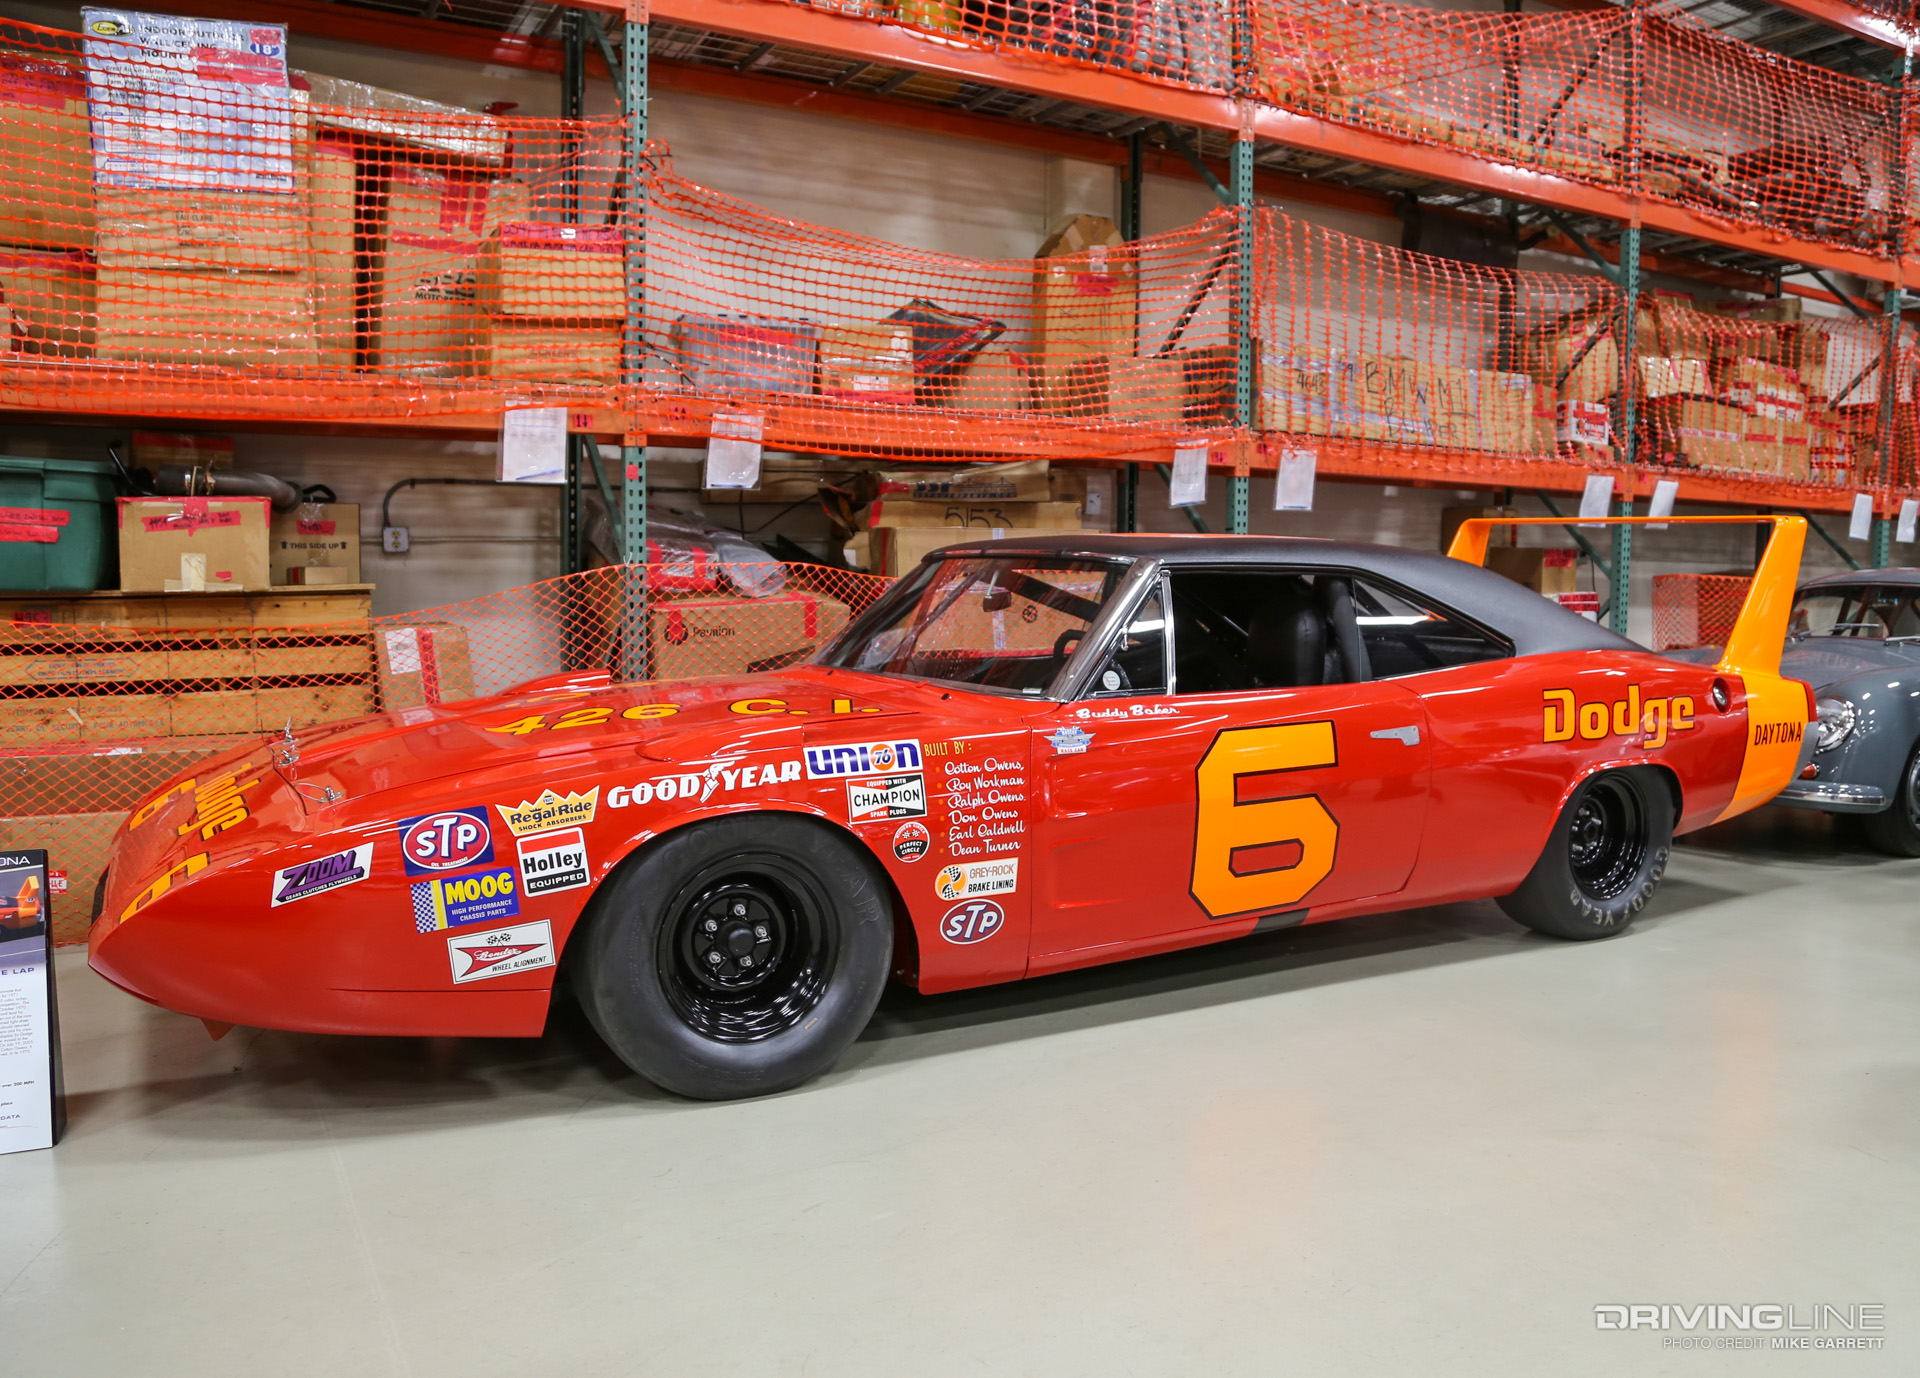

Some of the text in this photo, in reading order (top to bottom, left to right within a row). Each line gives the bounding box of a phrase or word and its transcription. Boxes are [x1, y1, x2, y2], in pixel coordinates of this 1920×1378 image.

[290, 542, 307, 550] THIS
[309, 542, 327, 550] SIDE
[485, 702, 682, 736] 426
[1076, 708, 1129, 719] Buddy
[1542, 683, 1695, 751] Dodge
[1754, 722, 1802, 746] DAYTONA
[924, 742, 949, 756] BUILT
[945, 761, 981, 775] Cotton
[607, 760, 802, 808] GOODYEAR
[866, 779, 892, 788] EQUIPPED
[946, 774, 1025, 792] Roy Workman
[854, 789, 920, 807] CHAMPION
[948, 792, 986, 809] Ralph
[519, 814, 587, 832] SHOCK ABSORBERS
[870, 810, 887, 818] SPARK
[948, 806, 1018, 825] Don Owens
[1188, 719, 1341, 920] 6
[415, 816, 478, 858] STP
[949, 820, 1026, 841] Earl Caldwell
[899, 841, 923, 850] PERFECT
[901, 847, 920, 855] CIRCLE
[948, 839, 1021, 857] Dean Turner
[523, 851, 583, 875] Holley
[970, 863, 1014, 879] GREY-ROCK
[278, 850, 360, 899] ZOOM
[530, 872, 584, 890] EQUIPPED
[285, 874, 357, 900] GEARS CLUTCHES FLYWHEELS
[445, 872, 514, 905] MOOG
[968, 879, 1014, 893] BRAKE LINING
[452, 899, 513, 916] HIGH PERFORMANCE
[460, 911, 485, 922] CHASSIS
[487, 907, 507, 917] PARTS
[946, 904, 999, 938] STP
[13, 967, 35, 975] LAP
[492, 955, 547, 972] WHEEL ALIGNMENT
